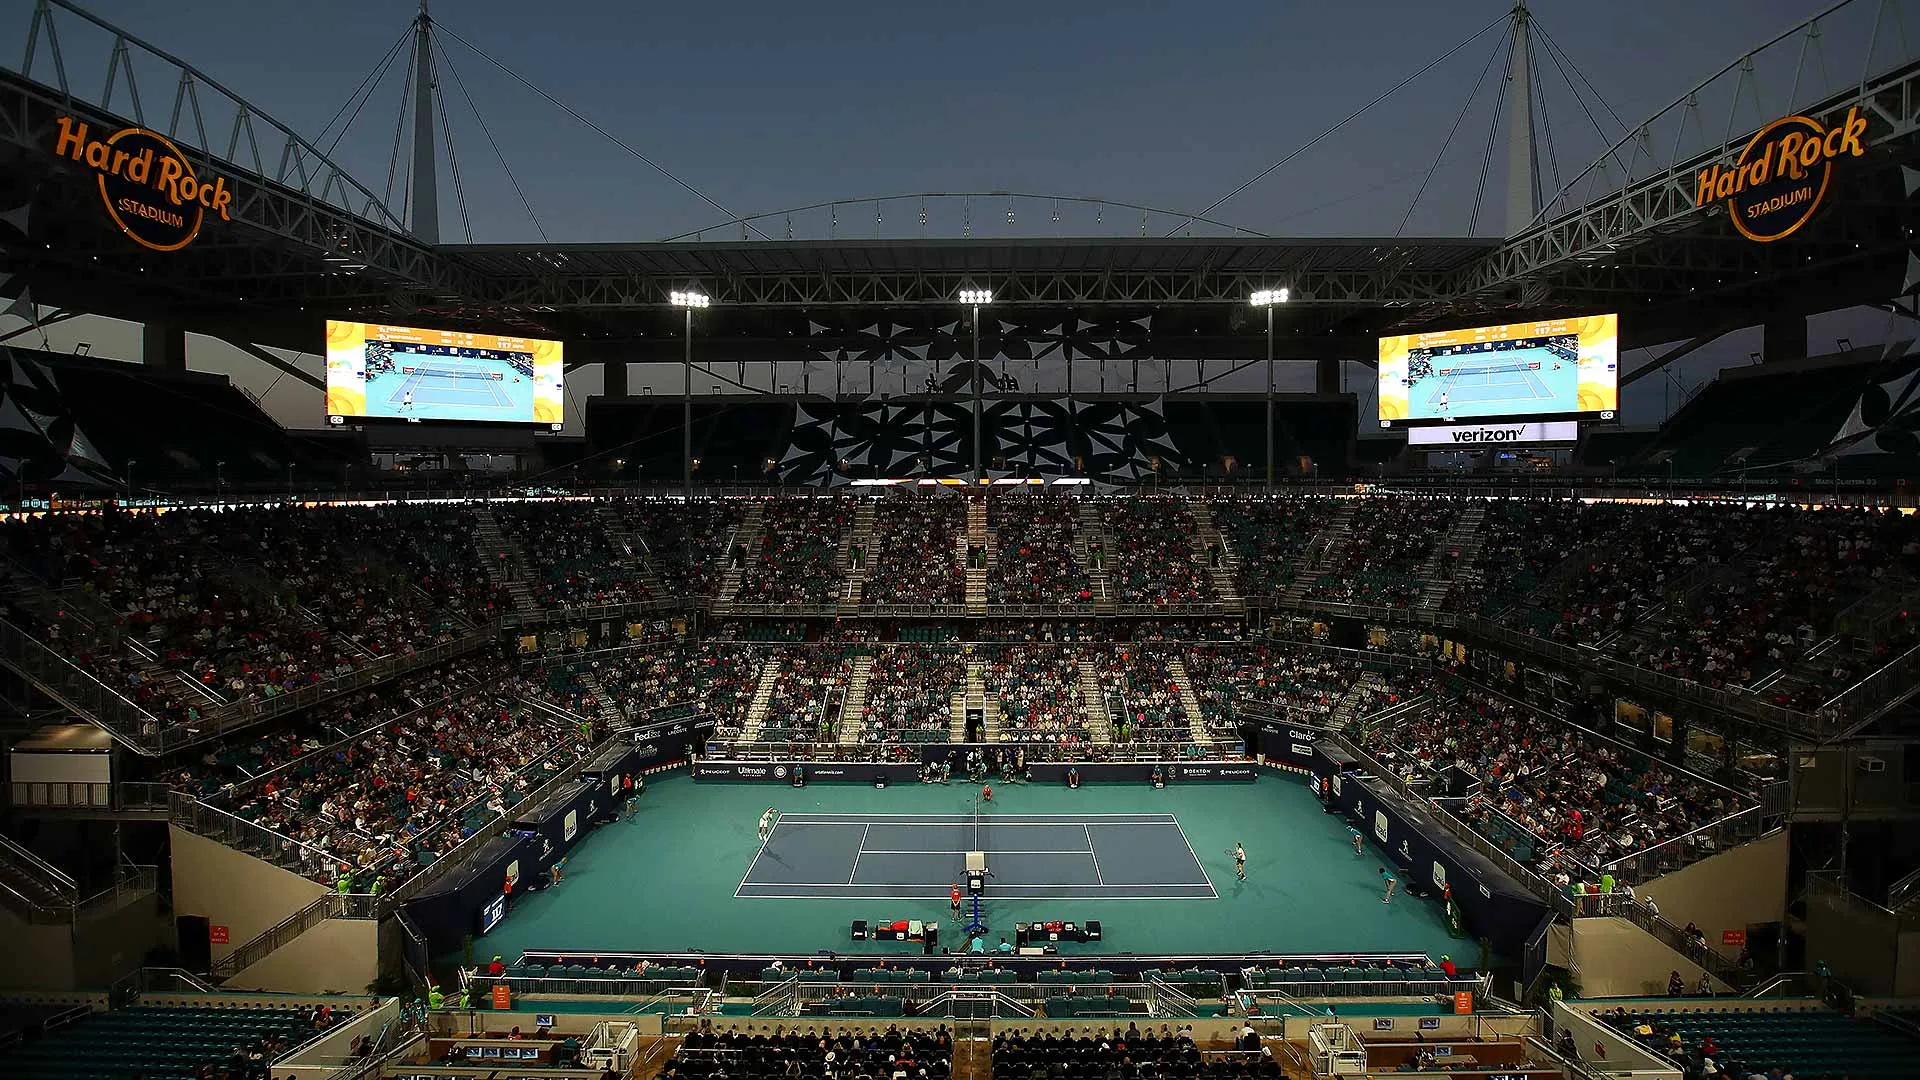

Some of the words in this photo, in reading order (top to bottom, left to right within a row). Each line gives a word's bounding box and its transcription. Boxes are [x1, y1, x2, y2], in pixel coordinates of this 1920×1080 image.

[56, 116, 153, 184] Hard
[158, 155, 232, 221] Rock
[1696, 140, 1774, 206] Hard
[1777, 106, 1867, 180] Rock
[118, 198, 183, 228] STADIUM
[1747, 187, 1811, 218] STADIUM
[1452, 428, 1517, 442] verizon
